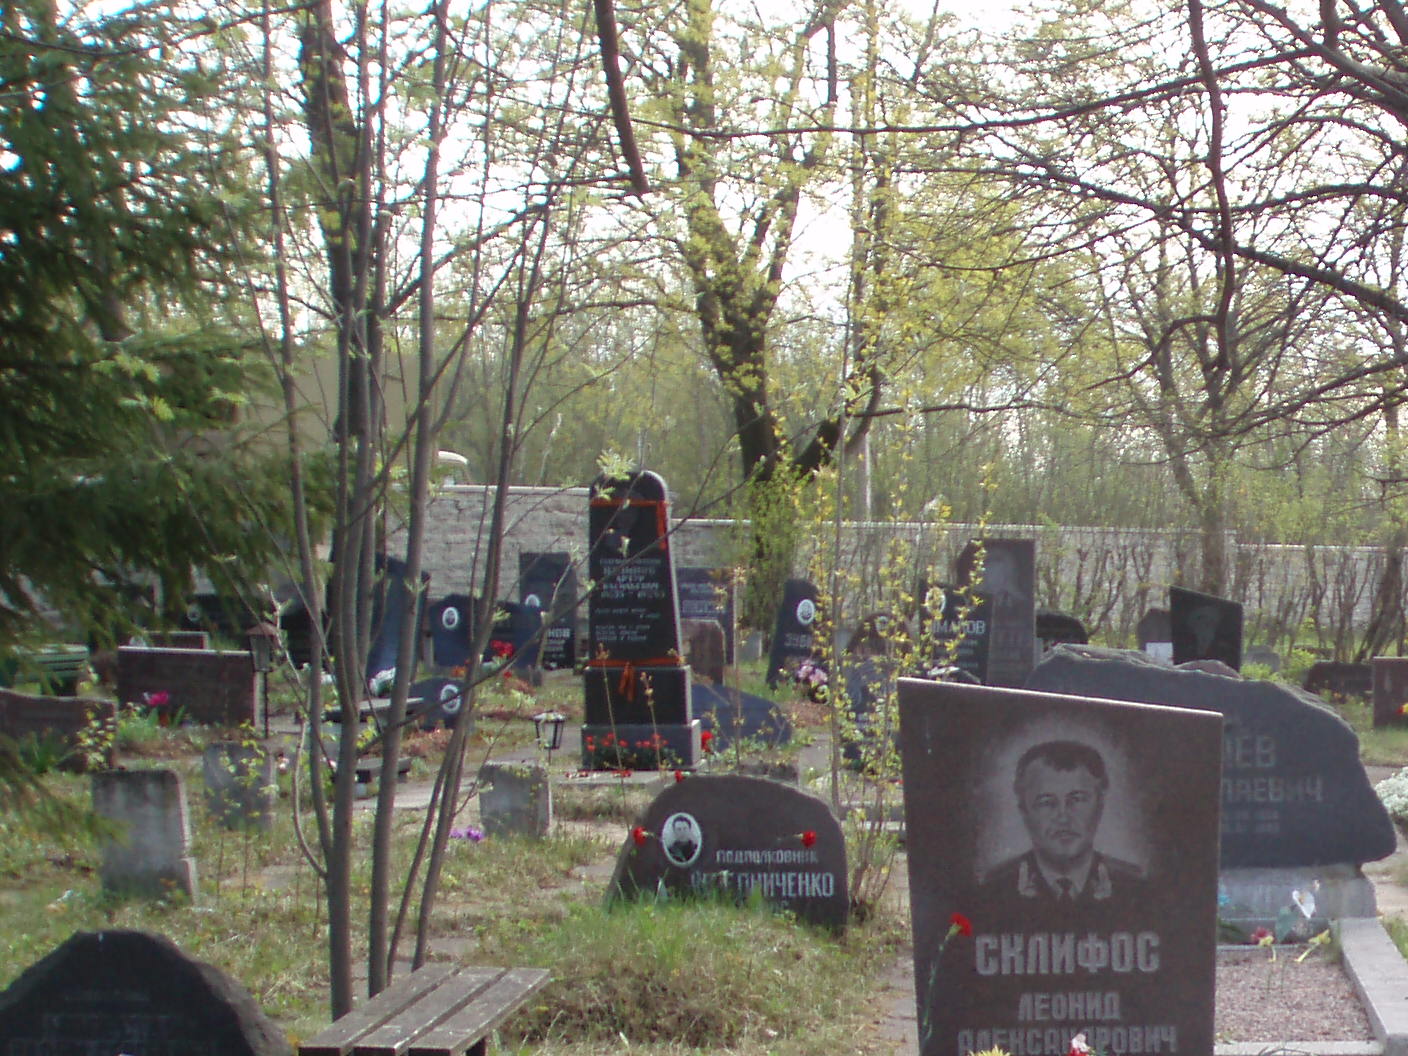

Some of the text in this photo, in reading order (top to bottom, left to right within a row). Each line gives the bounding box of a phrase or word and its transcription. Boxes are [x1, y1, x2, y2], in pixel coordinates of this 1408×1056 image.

[716, 849, 818, 864] ПОДПОЛКОВНИК
[975, 931, 1160, 976] СКЛИФОС
[1018, 991, 1121, 1022] ЛЕОНИД
